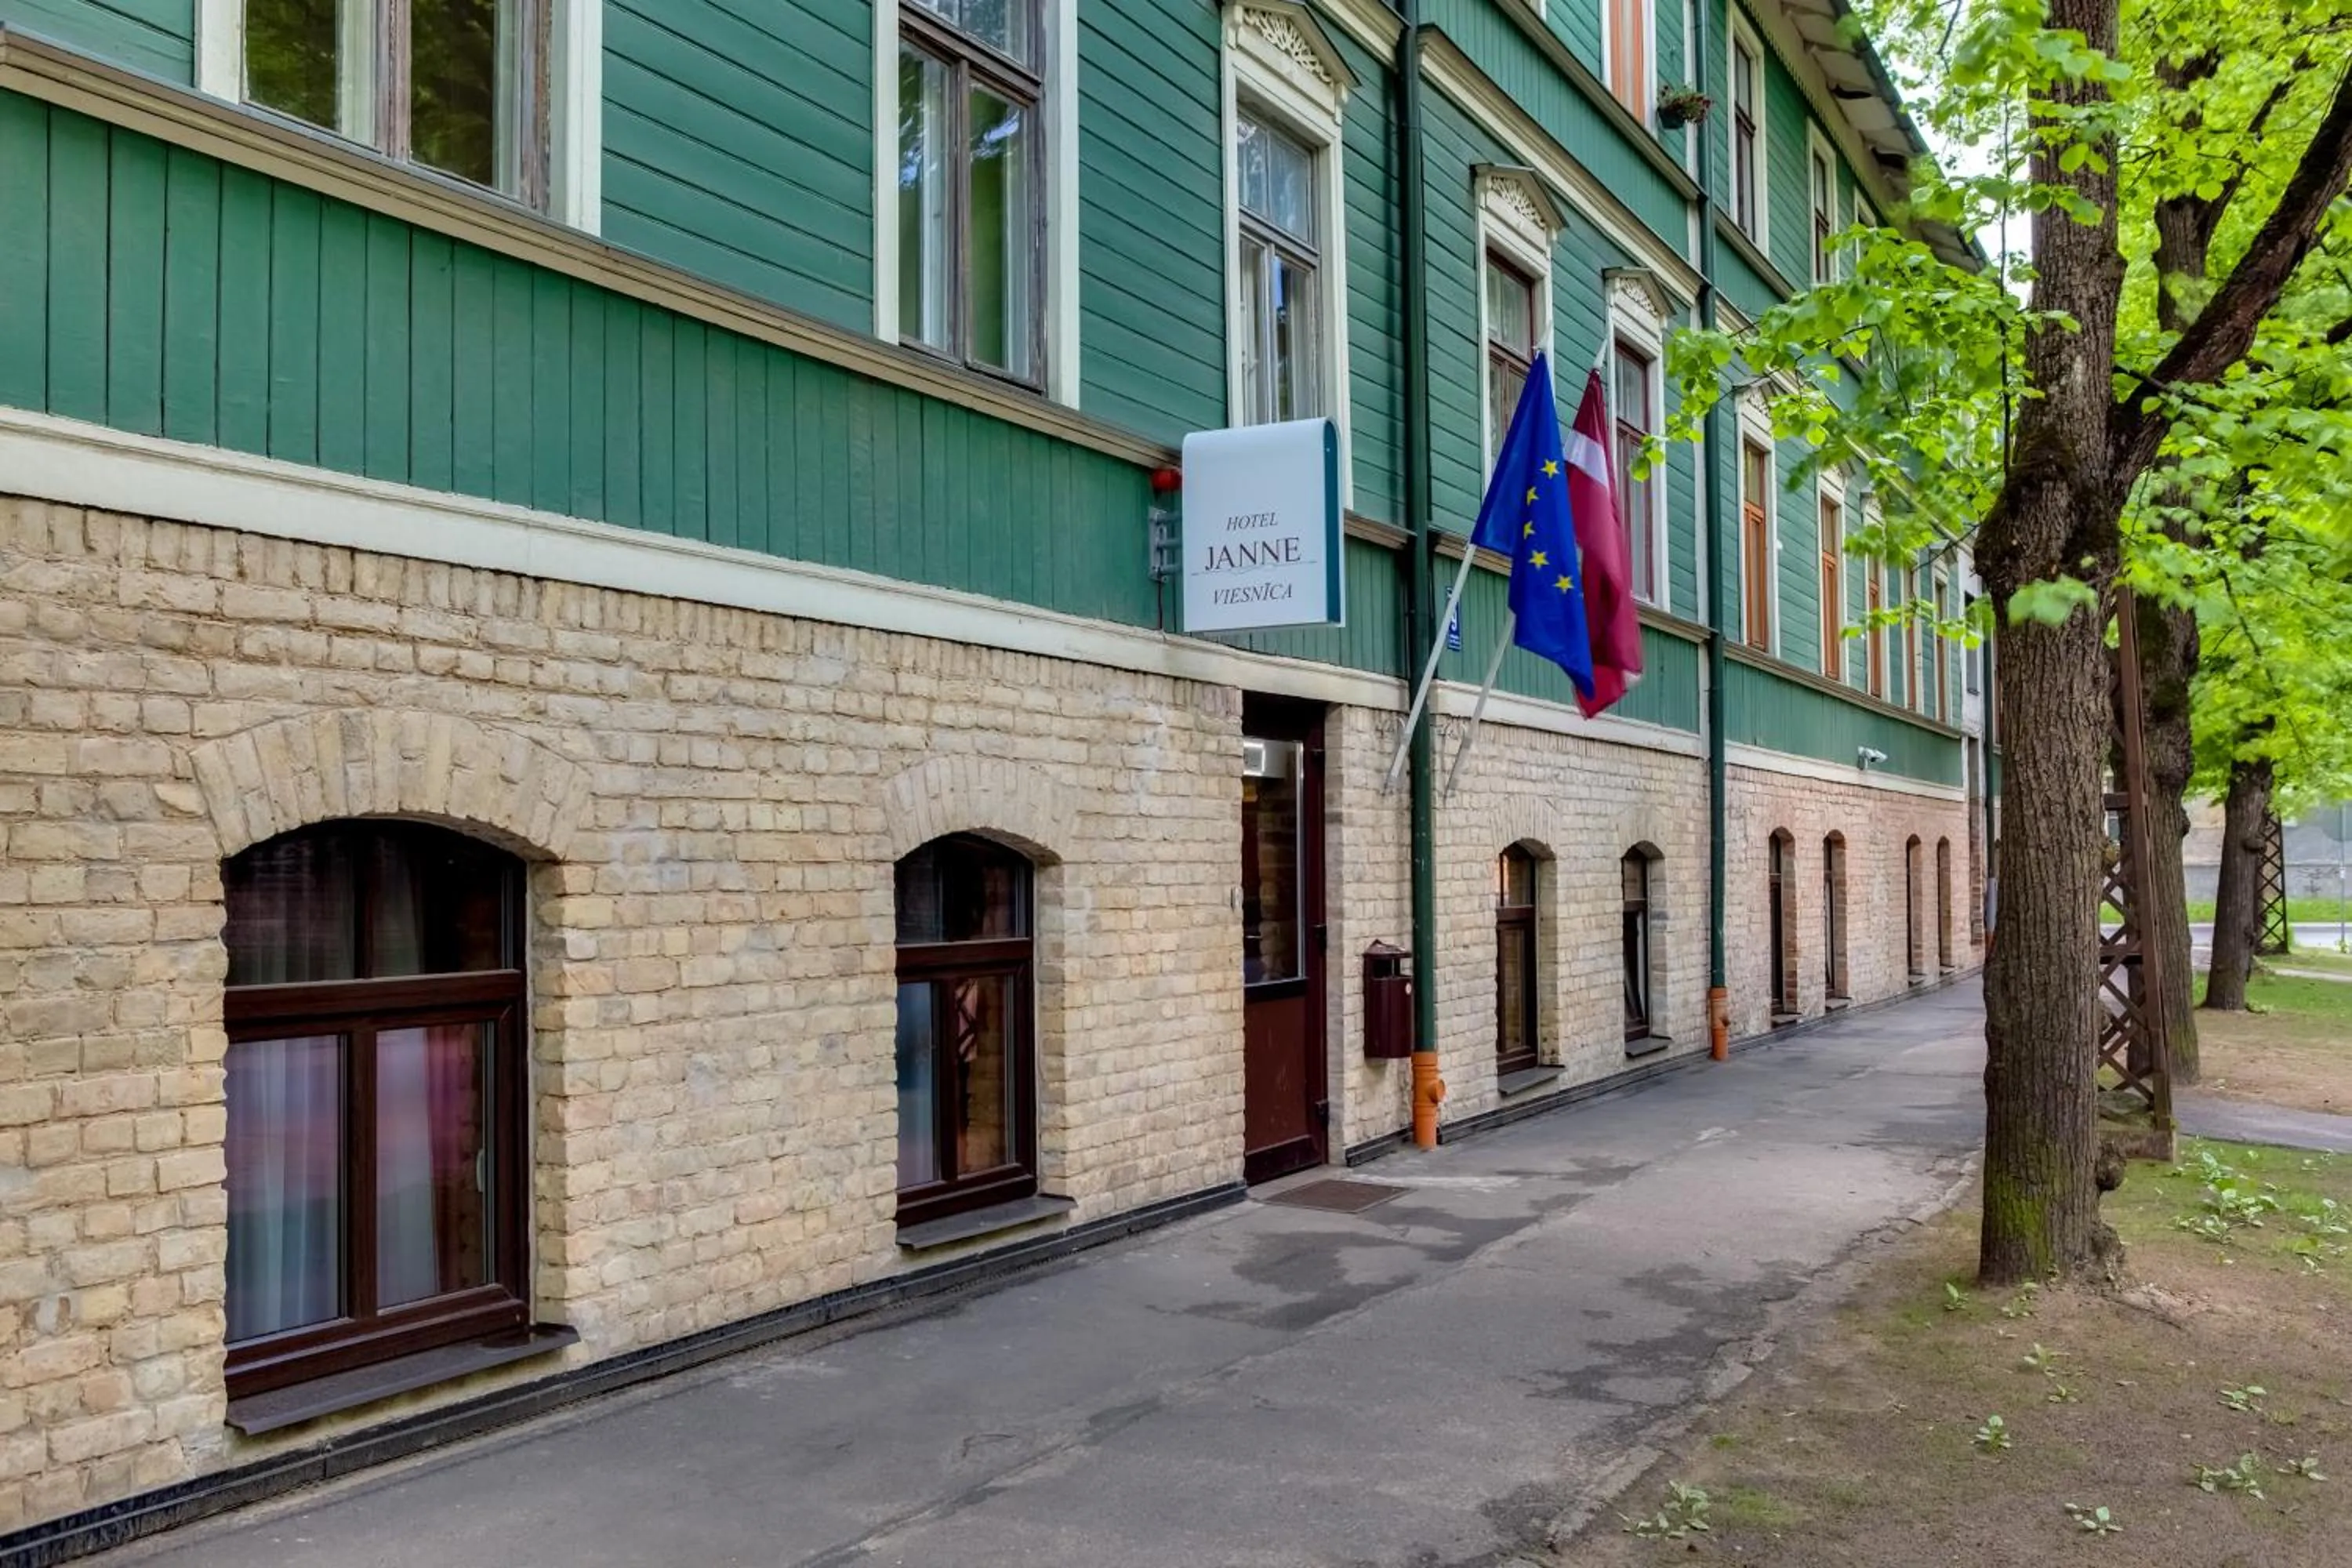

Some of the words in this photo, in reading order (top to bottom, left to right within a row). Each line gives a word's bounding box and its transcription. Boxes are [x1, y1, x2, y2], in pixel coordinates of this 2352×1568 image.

[1226, 512, 1279, 531] HOTEL
[1205, 537, 1301, 571] JANNE
[1214, 583, 1293, 604] VIESNĪCA
